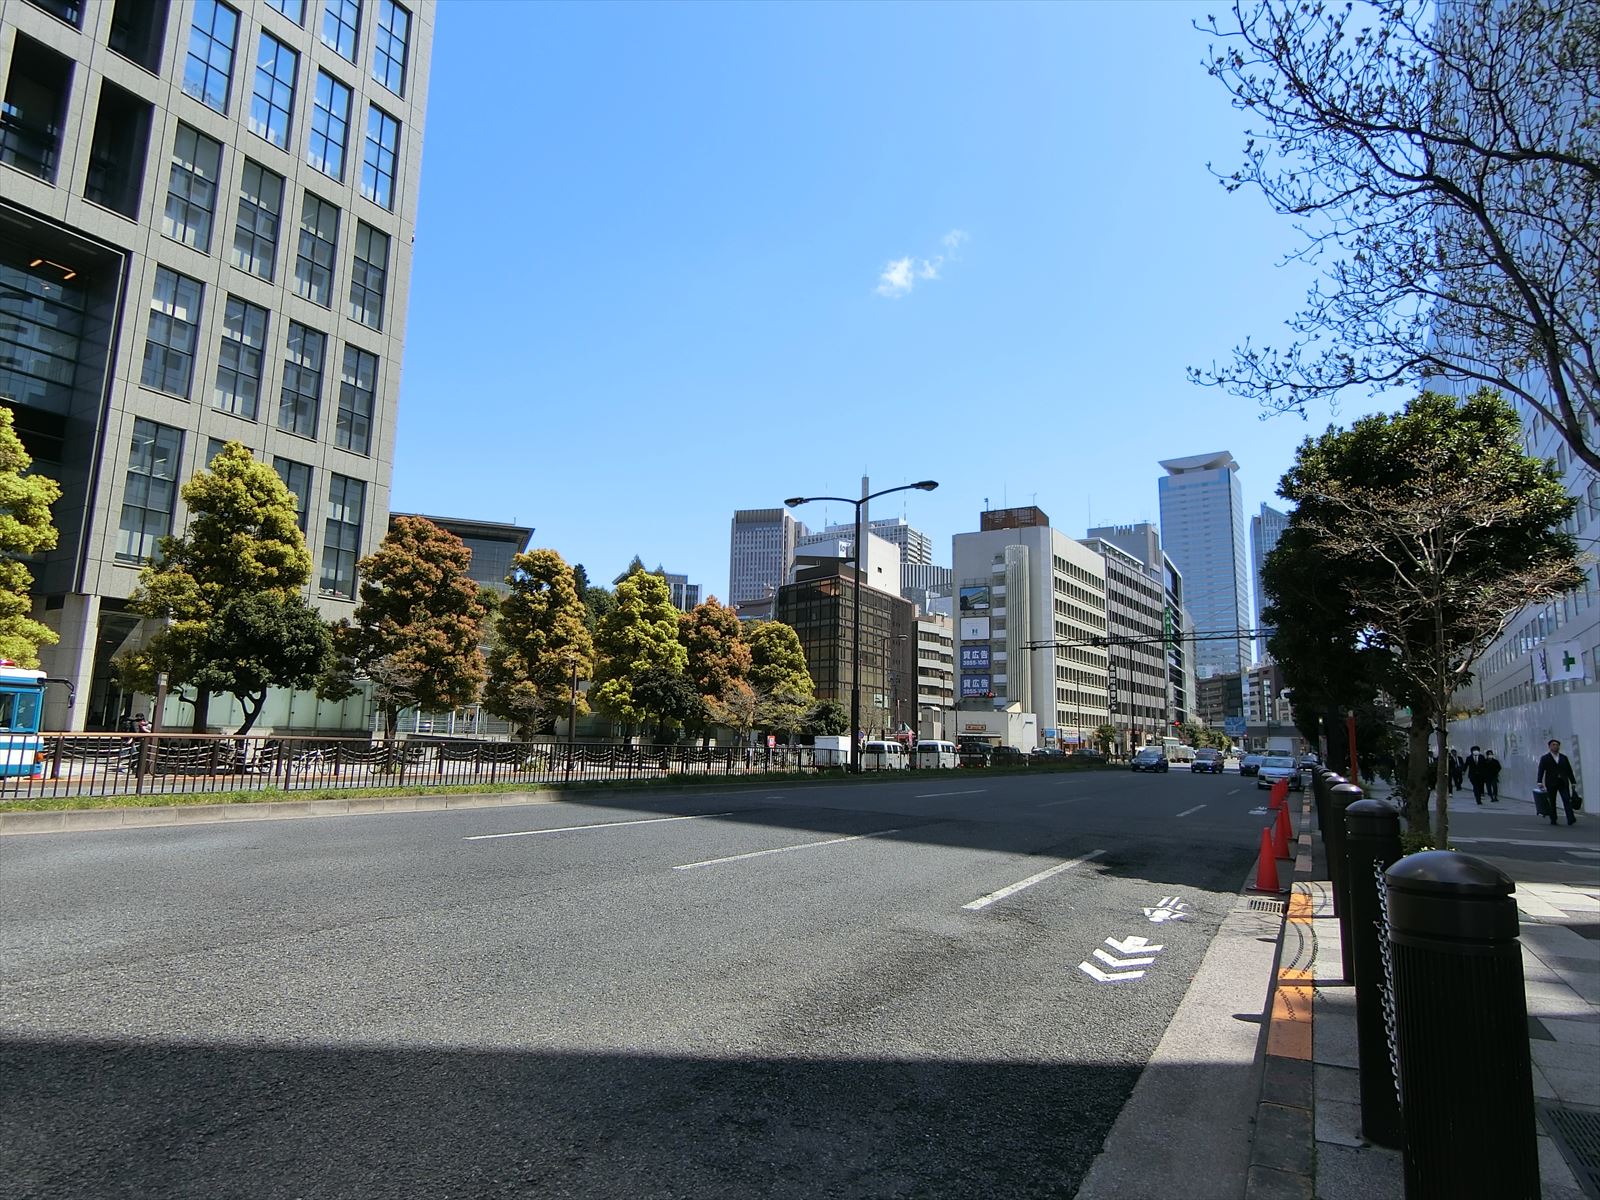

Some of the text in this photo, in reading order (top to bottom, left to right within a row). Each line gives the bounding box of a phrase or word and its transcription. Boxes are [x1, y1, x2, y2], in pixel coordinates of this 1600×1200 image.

[963, 650, 988, 659] 貸広告
[963, 679, 989, 688] 貸広告
